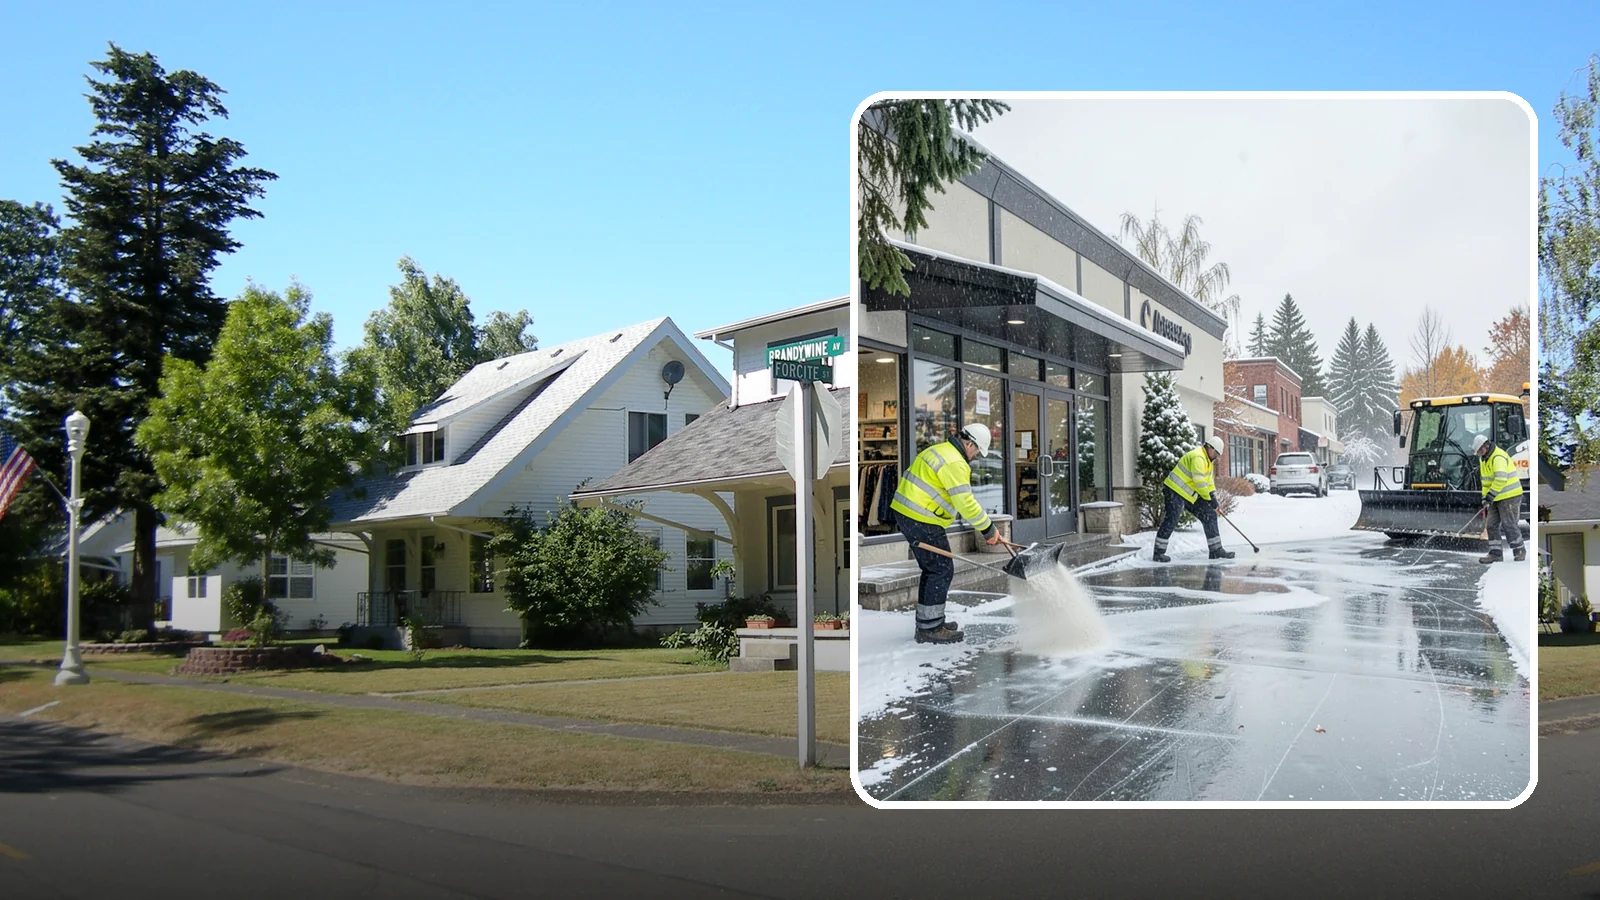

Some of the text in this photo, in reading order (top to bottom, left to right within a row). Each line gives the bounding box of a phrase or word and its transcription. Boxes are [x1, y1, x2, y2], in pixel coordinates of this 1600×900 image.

[769, 341, 841, 364] BRANDYWINE AV
[775, 362, 819, 380] FORCITE
